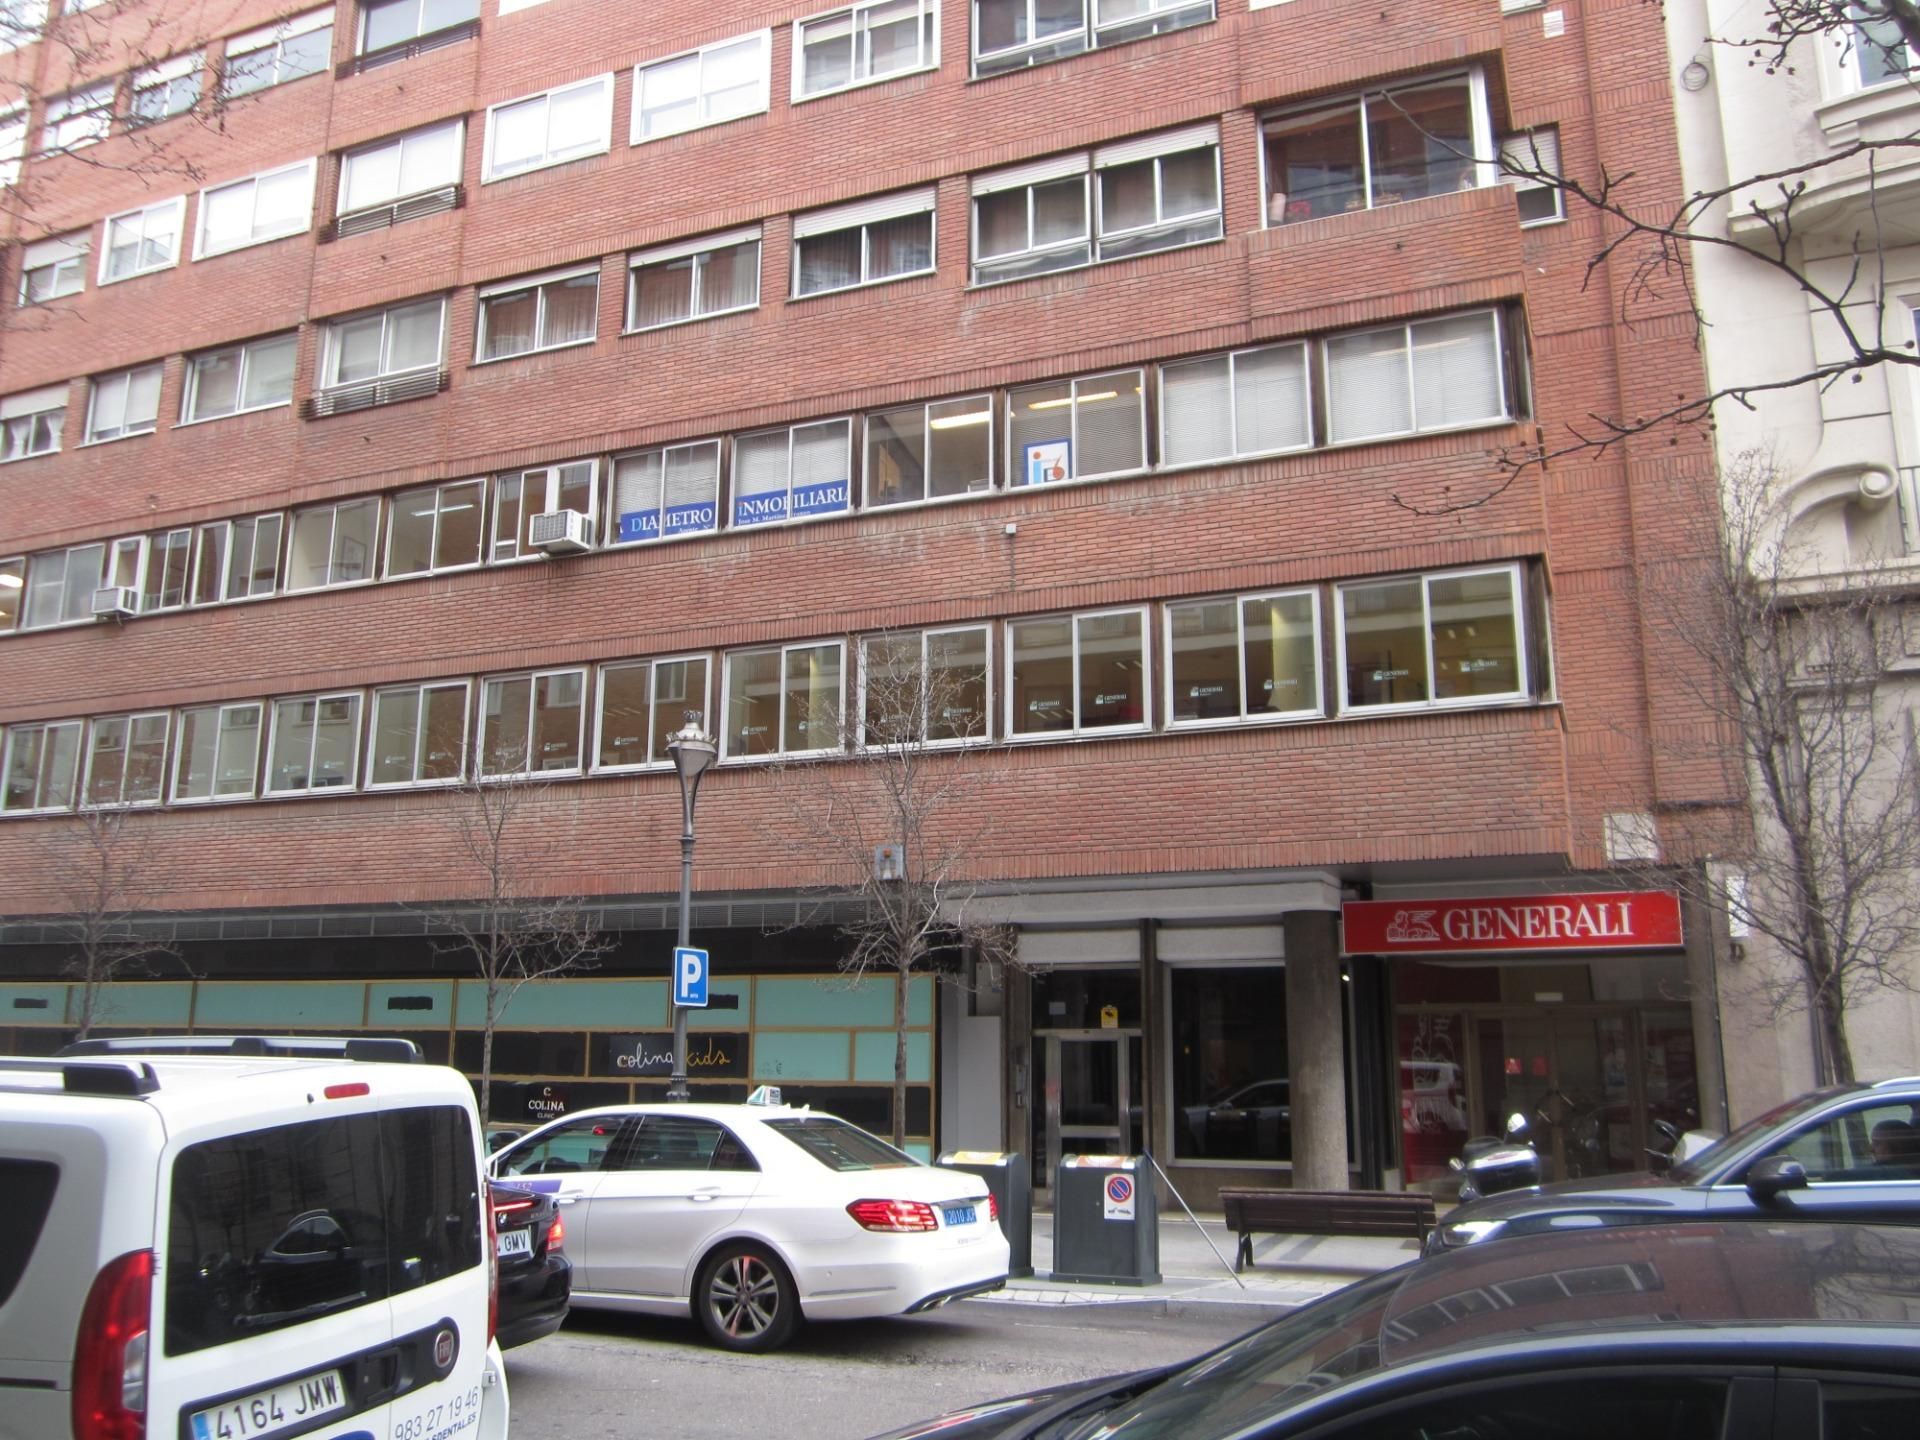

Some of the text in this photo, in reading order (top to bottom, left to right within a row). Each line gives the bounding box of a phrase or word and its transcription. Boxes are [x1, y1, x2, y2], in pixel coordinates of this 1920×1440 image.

[1443, 902, 1634, 940] GENERALI
[681, 954, 702, 998] P
[617, 1042, 675, 1068] colina
[686, 1037, 731, 1067] kids
[528, 1100, 565, 1111] COLINA
[504, 1233, 526, 1252] GMV
[216, 1375, 338, 1440] 4164 JMW
[395, 1386, 478, 1440] 983 27 19 46
